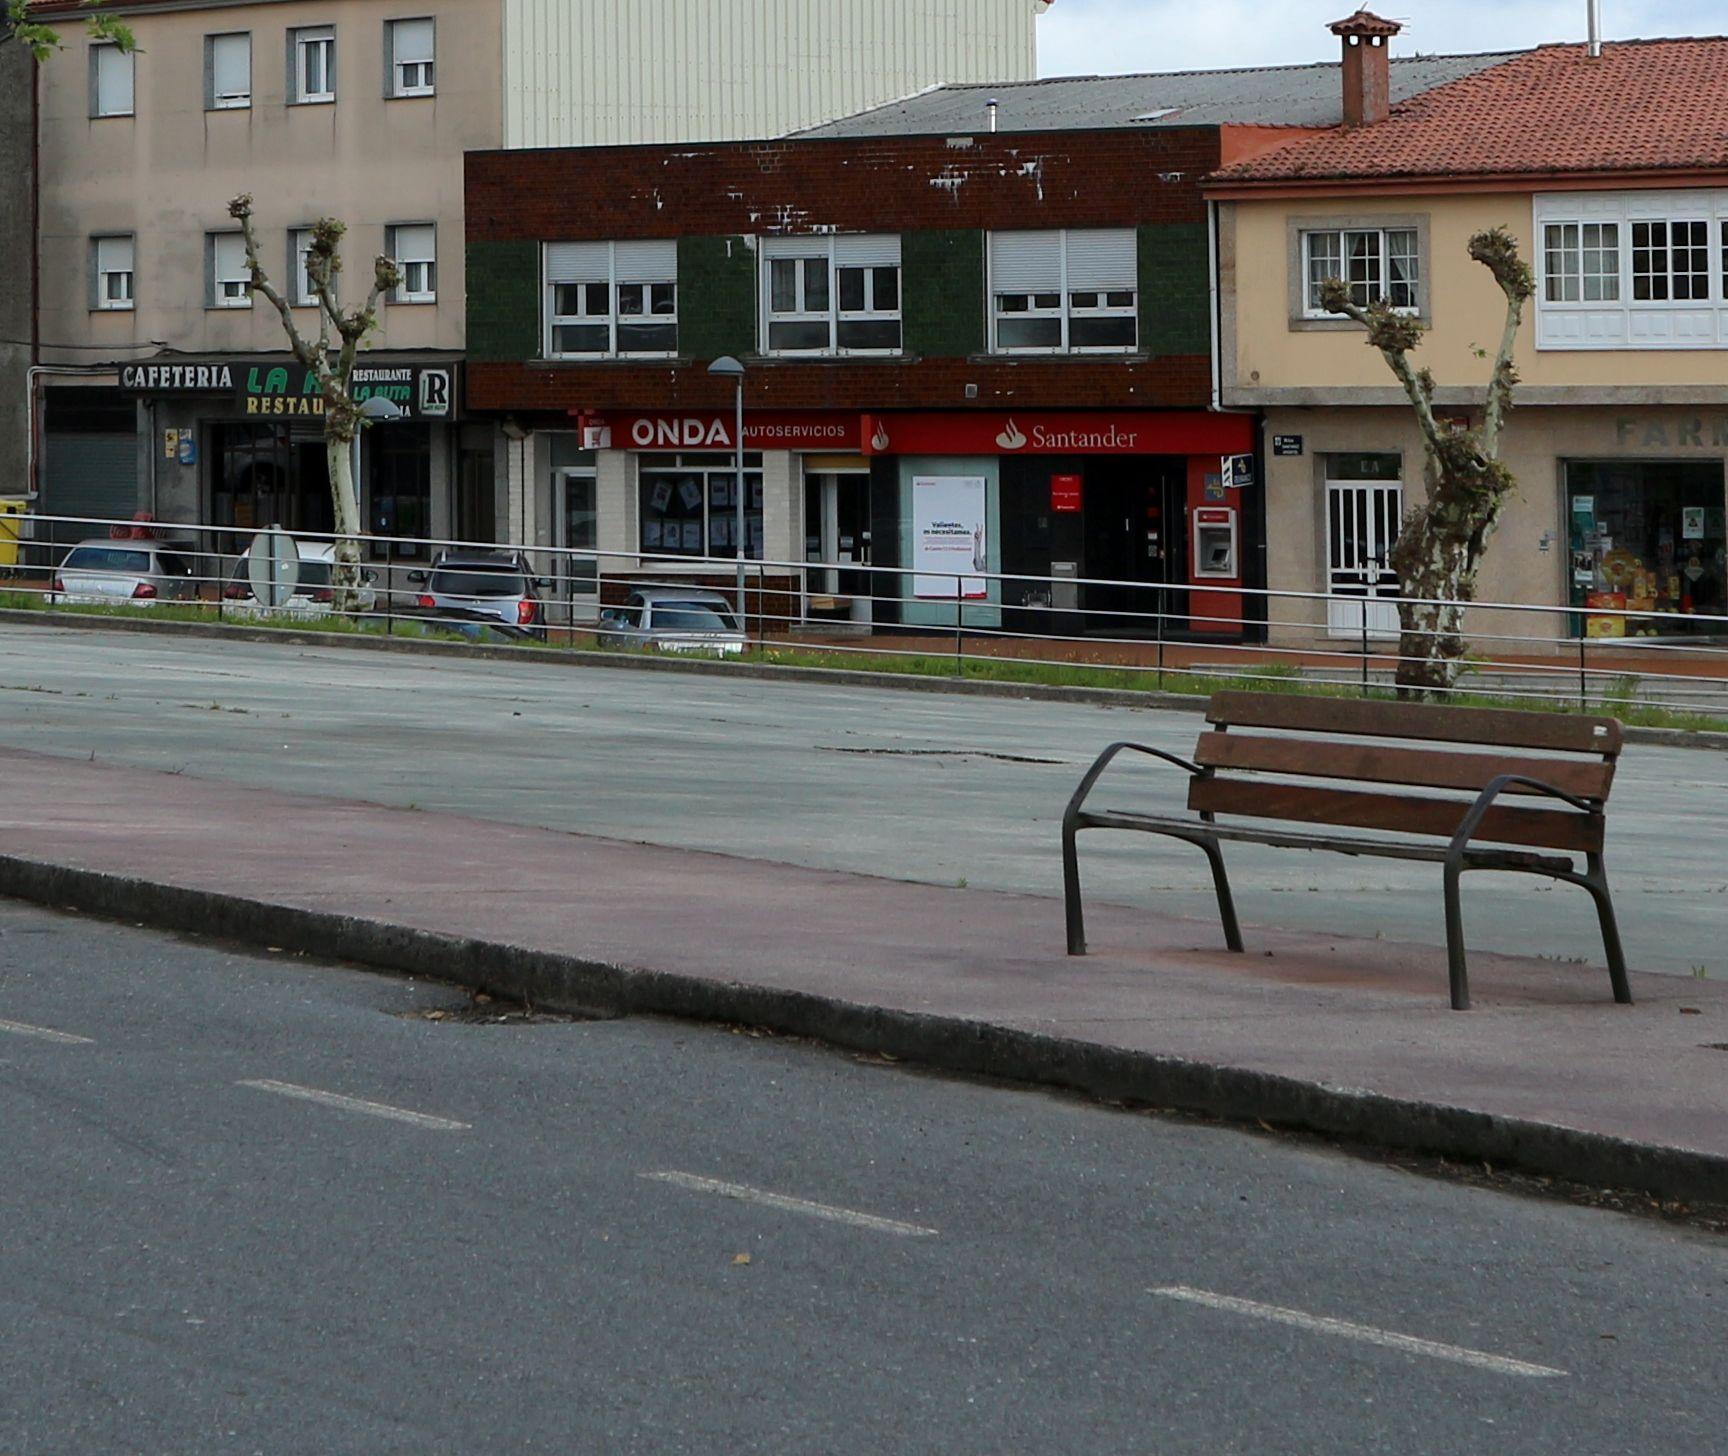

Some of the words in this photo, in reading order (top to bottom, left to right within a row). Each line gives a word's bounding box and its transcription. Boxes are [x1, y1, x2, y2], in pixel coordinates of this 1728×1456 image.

[123, 365, 233, 389] CAFETERIA
[247, 367, 288, 394] LA
[352, 368, 412, 382] RESTAURANTE
[246, 396, 325, 415] RESTAU
[353, 386, 372, 401] LA
[632, 418, 730, 445] ONDA
[742, 425, 845, 438] AUTOSERVICIOS
[1033, 424, 1137, 448] Santander
